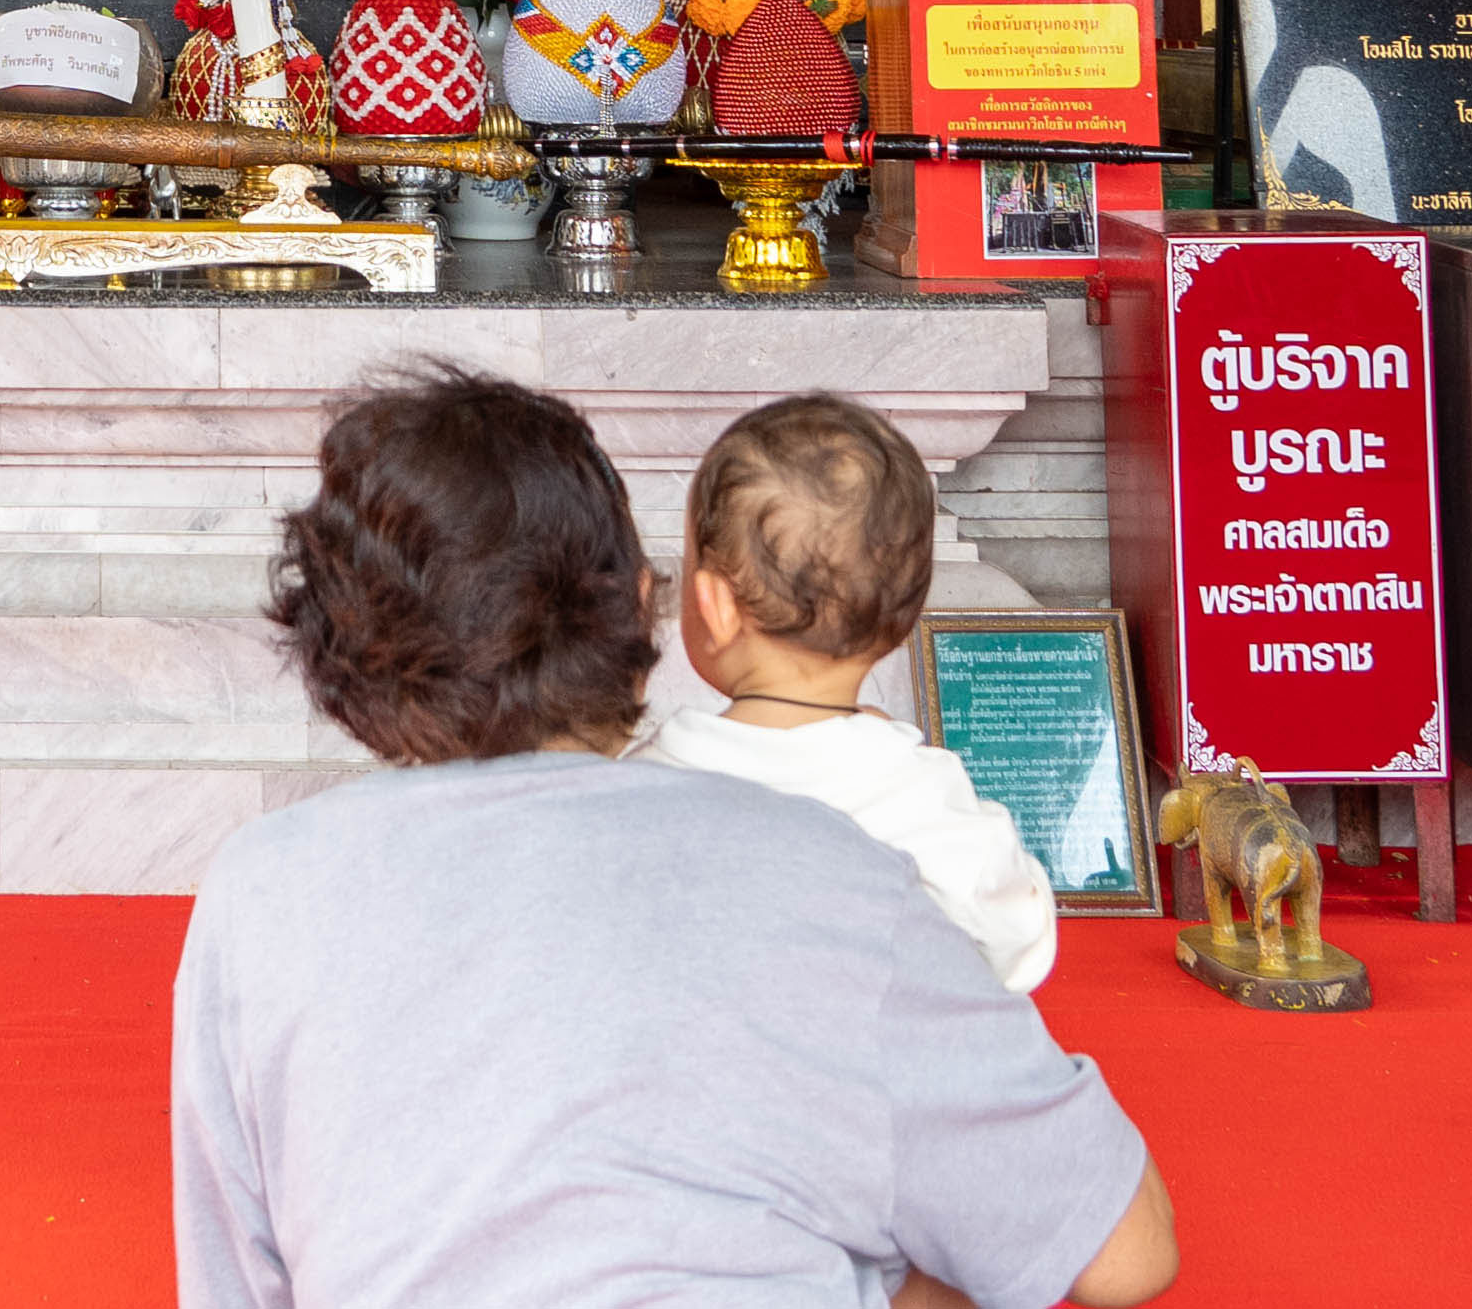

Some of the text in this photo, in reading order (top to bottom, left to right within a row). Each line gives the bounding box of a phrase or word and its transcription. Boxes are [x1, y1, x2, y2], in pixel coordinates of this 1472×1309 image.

[966, 10, 1099, 35] เพื่อสนับสนุนกองทุน
[1358, 36, 1423, 60] โอมสิโน
[1074, 67, 1081, 77] 5
[1201, 329, 1409, 411] ตู้บริจาค
[1231, 428, 1386, 492] บูรณะ
[1224, 507, 1389, 549] ศาลสมเด็จ
[1199, 573, 1423, 615] พระเจ้าตากสิน
[1249, 642, 1373, 673] มหาราช
